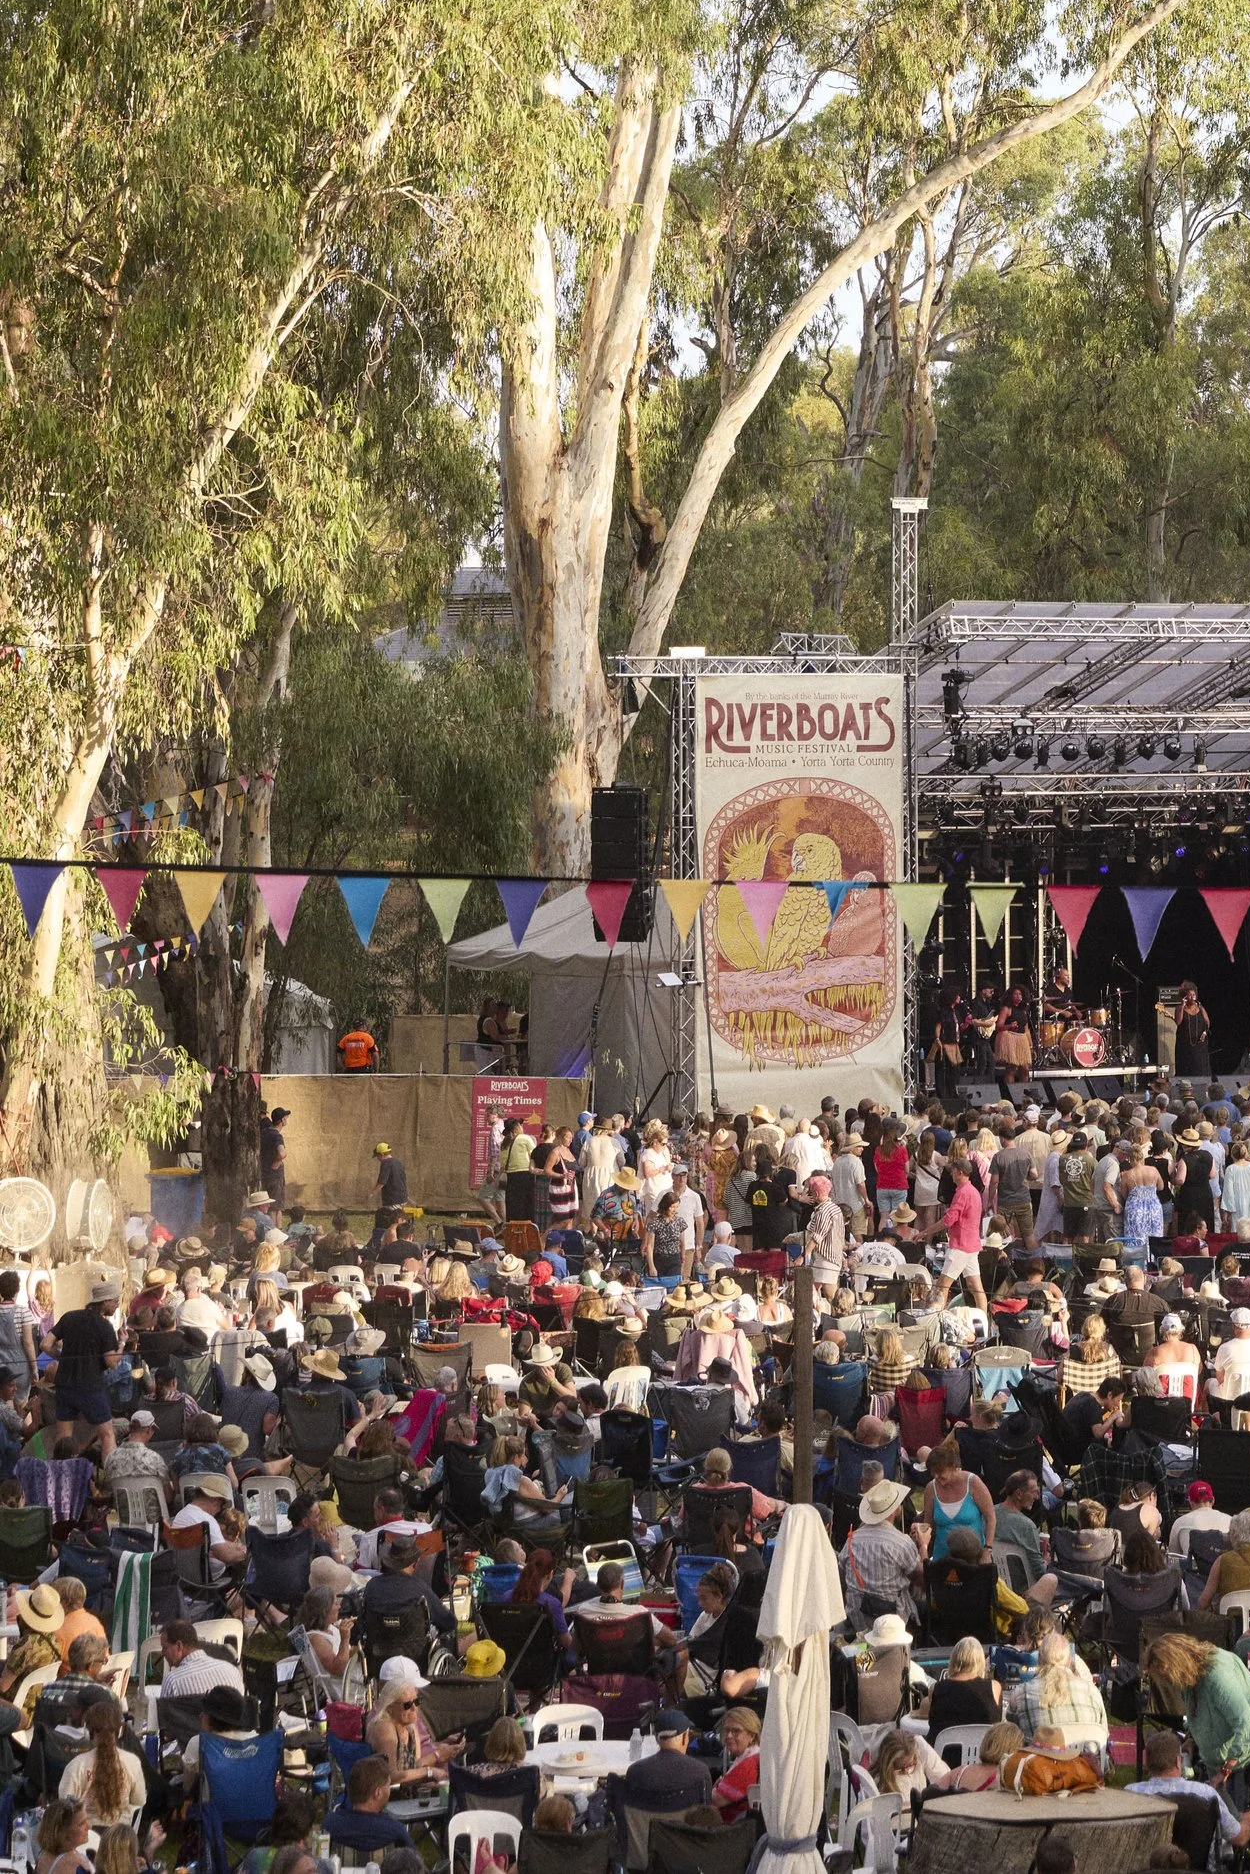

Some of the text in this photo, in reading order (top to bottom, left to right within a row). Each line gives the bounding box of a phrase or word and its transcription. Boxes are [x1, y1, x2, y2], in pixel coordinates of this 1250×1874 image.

[745, 692, 754, 701] By
[756, 692, 768, 700] the
[770, 692, 790, 700] banks
[792, 692, 799, 700] of
[800, 692, 812, 700] the
[813, 693, 838, 701] Murray
[705, 697, 895, 753] RIVERBOATS
[755, 743, 853, 753] MUSIC FESTIVAL
[705, 756, 895, 768] Echuca-Moama Yorta Yorta Country
[490, 1080, 529, 1092] RIVERBOATS
[477, 1095, 543, 1107] Playing Times
